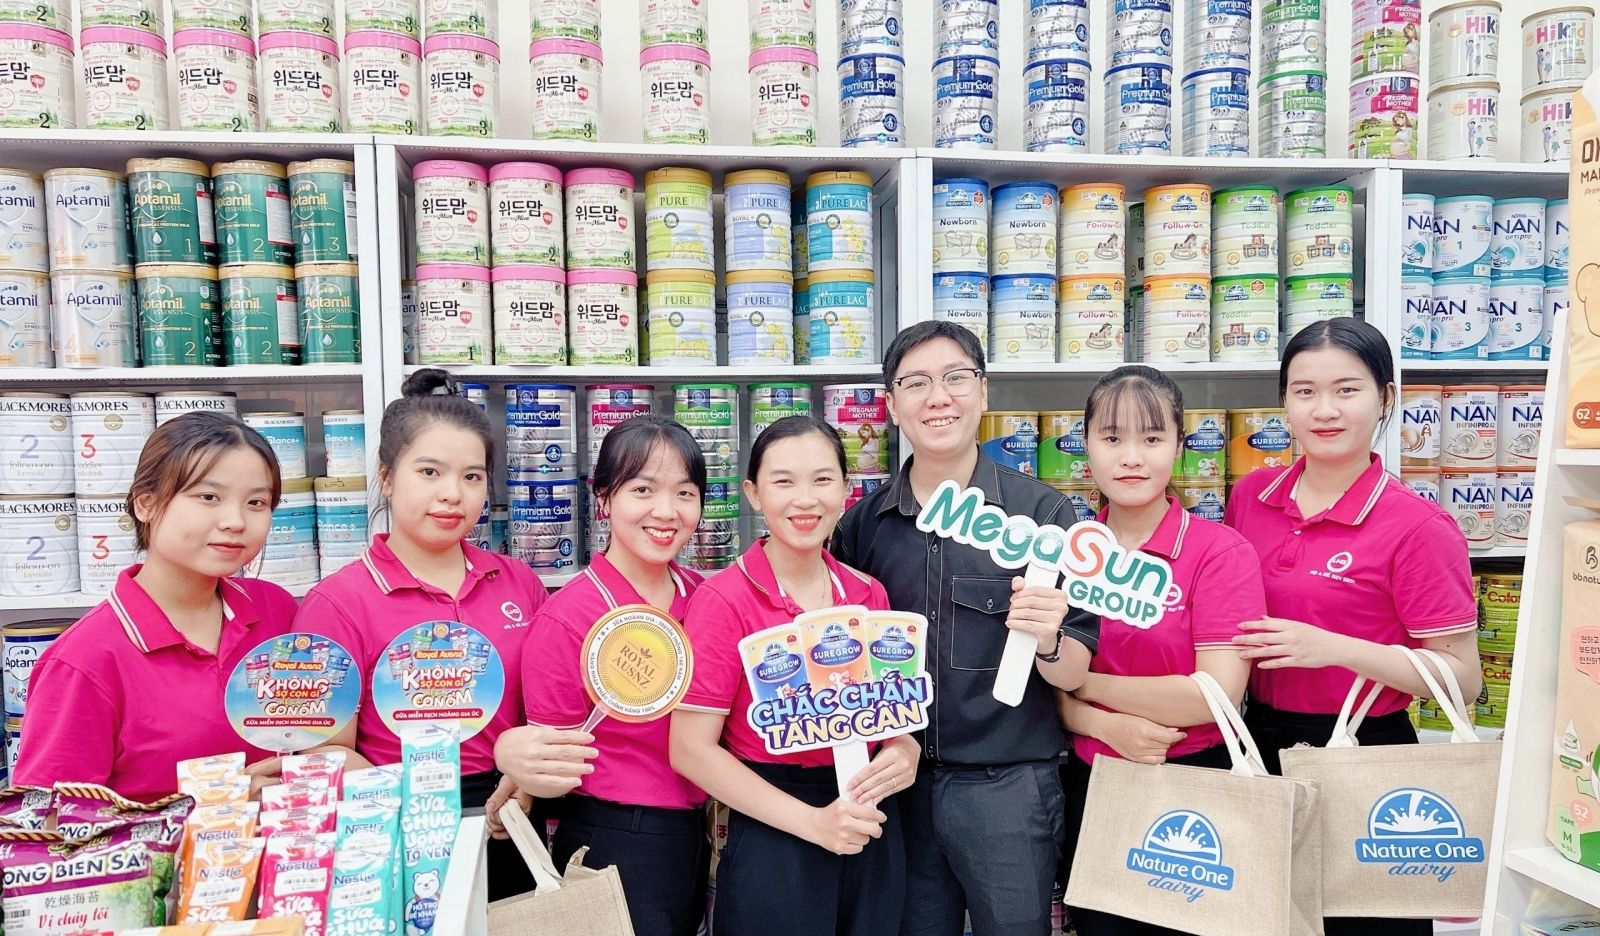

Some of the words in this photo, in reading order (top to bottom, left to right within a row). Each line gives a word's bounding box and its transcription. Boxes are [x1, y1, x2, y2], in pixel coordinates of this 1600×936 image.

[1536, 22, 1586, 44] Hikid
[84, 65, 126, 83] 위드맘
[179, 68, 223, 86] 위드맘
[273, 69, 322, 88] 위드맘
[353, 69, 400, 88] 위드맘
[430, 72, 474, 90] 위드맘
[536, 75, 578, 93] 위드맘
[650, 81, 695, 99] 위드맘
[842, 79, 873, 94] Premium
[938, 81, 972, 94] Premium
[976, 80, 993, 92] Gold
[1030, 83, 1066, 96] Premium
[1068, 83, 1086, 95] Gold
[759, 83, 802, 100] 위드맘
[1122, 88, 1161, 99] Premium
[1212, 92, 1247, 103] Premium
[1286, 96, 1321, 105] Premium
[56, 194, 110, 208] Aptamil
[134, 193, 181, 206] Aptamil
[422, 198, 467, 215] 위드맘
[822, 199, 867, 209] PURELAC
[499, 200, 543, 217] 위드맘
[575, 205, 619, 222] 위드맘
[940, 219, 977, 227] Newborn
[1010, 220, 1046, 228] Newborn
[1163, 222, 1203, 230] Follow-On
[1304, 222, 1337, 230] Toddler
[1433, 218, 1460, 235] AN
[1494, 219, 1540, 233] NAN
[185, 238, 193, 253] 1
[254, 238, 264, 252] 2
[329, 237, 339, 251] 3
[1457, 241, 1463, 249] 1
[67, 293, 122, 307] Aptamil
[305, 296, 352, 309] Aptamil
[744, 296, 788, 305] PURELAC
[820, 296, 865, 305] PURELAC
[420, 300, 460, 317] 위드맘
[510, 301, 555, 318] 위드맘
[577, 303, 620, 320] 위드맘
[1432, 300, 1466, 315] AN
[1489, 301, 1516, 315] AN
[1465, 322, 1471, 332] 3
[1515, 322, 1522, 332] 3
[1259, 332, 1266, 341] 3
[185, 342, 195, 356] 2
[261, 342, 272, 355] 2
[352, 339, 361, 353] 3
[0, 402, 71, 412] LACKMORES
[755, 408, 793, 418] Premium
[1451, 406, 1496, 422] NAN
[1576, 408, 1590, 419] 62
[539, 411, 560, 420] Gold
[594, 410, 631, 420] Premium
[674, 409, 708, 420] Premium
[710, 409, 730, 419] Gold
[1512, 407, 1542, 422] NA
[20, 434, 39, 458] 2
[81, 434, 95, 458] 3
[1187, 439, 1224, 447] SUREGROW
[1252, 438, 1291, 446] SUREGROW
[1453, 488, 1495, 503] NAN
[1502, 487, 1533, 502] NA
[514, 506, 549, 517] Premium
[553, 506, 571, 515] Gold
[26, 536, 46, 560] 2
[93, 536, 109, 560] 3
[1069, 580, 1157, 622] GROUP
[416, 650, 439, 660] Royal
[814, 645, 861, 659] SUREGROW
[872, 646, 914, 655] SUREGROW
[6, 658, 36, 669] Aptam
[274, 661, 297, 671] Royal
[620, 645, 656, 680] ROYAL
[759, 659, 799, 677] SUREGROW
[402, 664, 473, 690] KHÔNG
[612, 656, 651, 690] AUSNZ
[257, 674, 331, 699] KHÔNG
[434, 678, 453, 688] CON
[290, 690, 308, 698] CON
[411, 692, 446, 708] CON
[264, 701, 296, 717] CON
[752, 683, 838, 728] CHẮC
[762, 714, 851, 750] TĂNG
[854, 699, 922, 738] CÂN
[1574, 804, 1589, 819] 52
[1560, 815, 1575, 827] TAPE
[1563, 831, 1573, 843] M
[1362, 843, 1432, 858] Nature
[1435, 842, 1479, 859] One
[3, 866, 48, 885] ONG
[1131, 852, 1189, 877] Nature
[1191, 865, 1229, 886] One
[1388, 862, 1457, 883] dairy
[1148, 876, 1205, 903] dairy
[45, 890, 99, 909] 乾燥海苔
